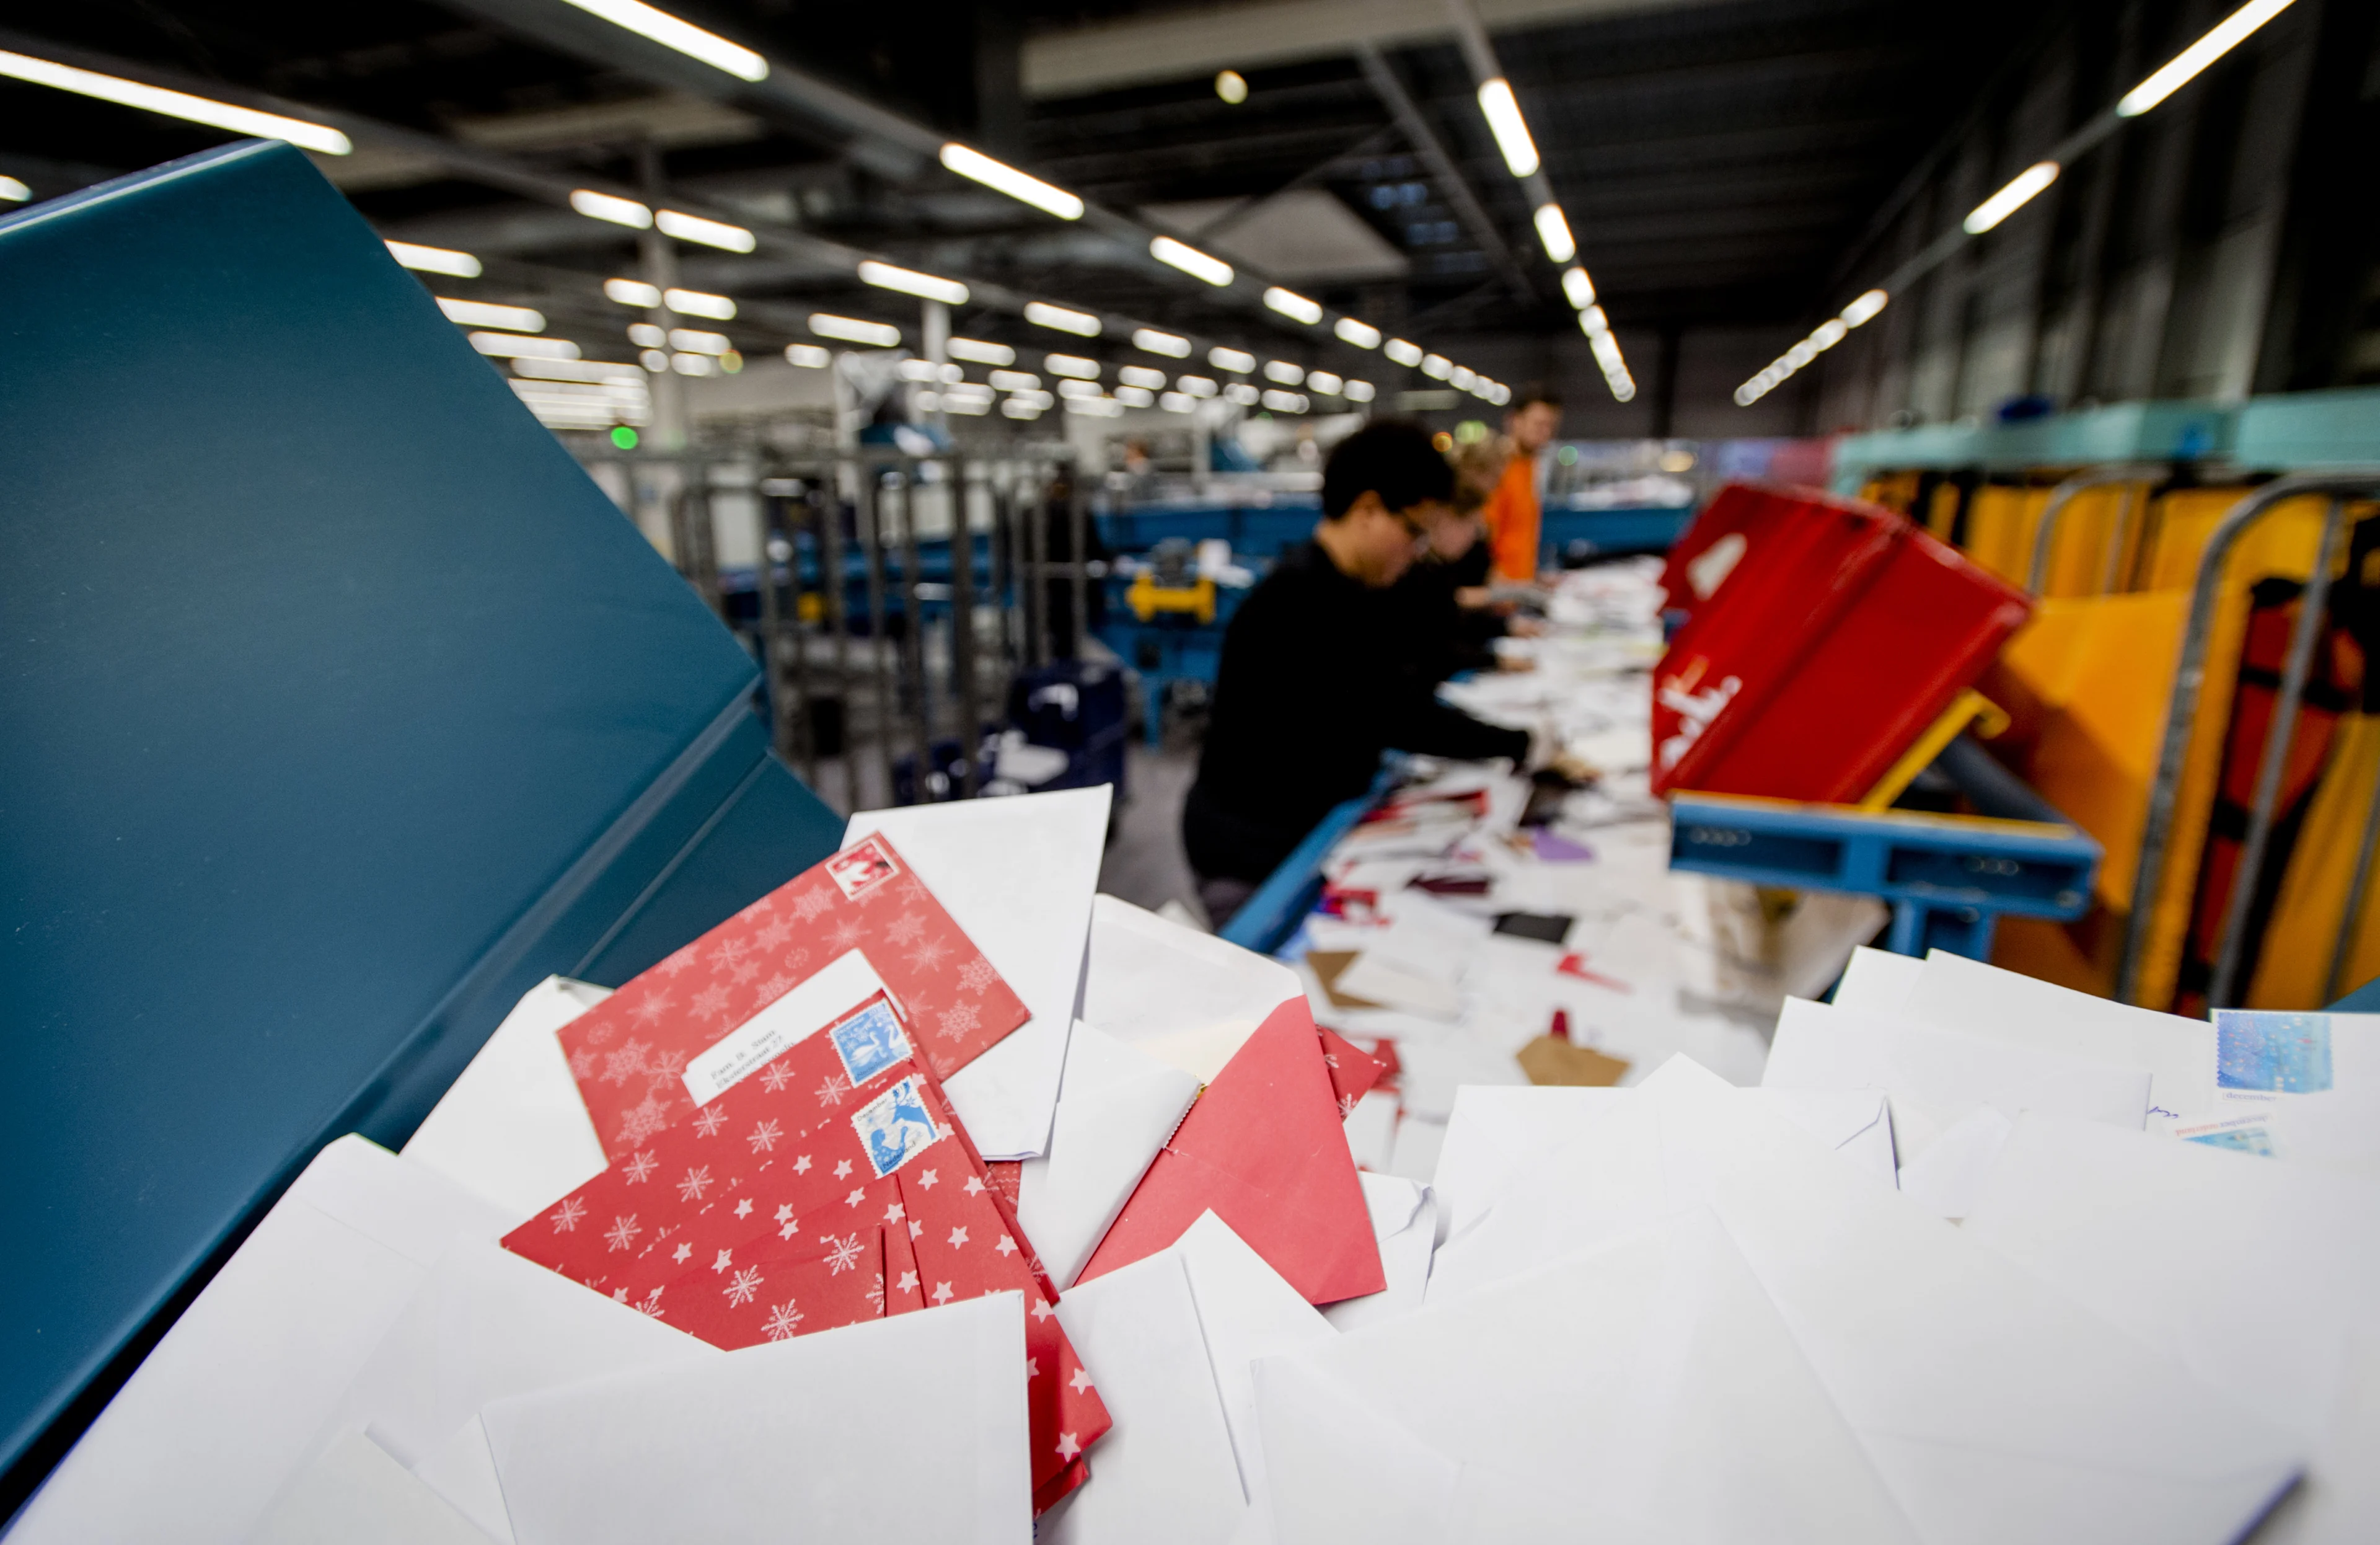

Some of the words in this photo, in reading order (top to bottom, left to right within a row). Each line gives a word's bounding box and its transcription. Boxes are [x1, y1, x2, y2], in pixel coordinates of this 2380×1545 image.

[857, 1097, 888, 1122] December
[2226, 1092, 2277, 1102] december
[882, 1140, 917, 1170] Nederland
